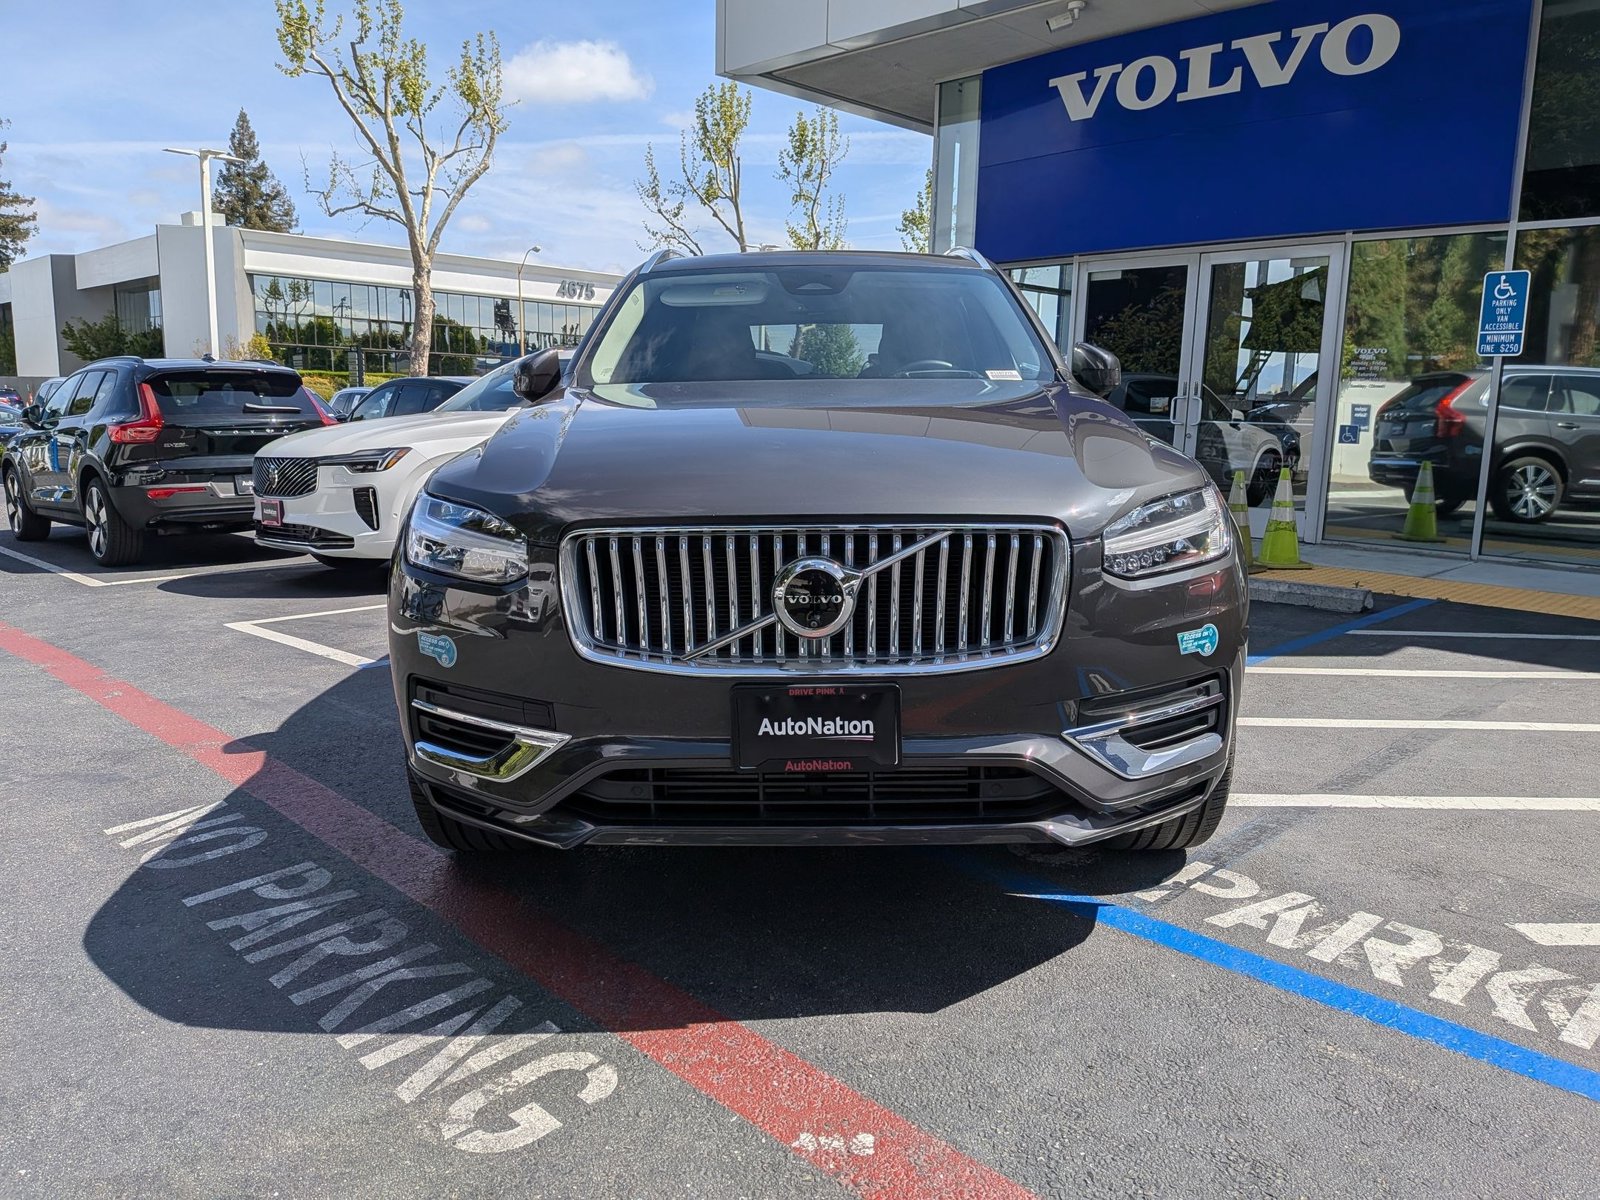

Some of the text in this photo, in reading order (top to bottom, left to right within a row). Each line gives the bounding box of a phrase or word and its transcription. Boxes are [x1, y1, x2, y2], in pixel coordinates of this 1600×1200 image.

[1049, 14, 1400, 121] VOLVO
[556, 280, 595, 301] 4675
[1492, 299, 1517, 307] PARKING
[1495, 307, 1512, 315] ONLY
[1485, 322, 1519, 331] ACCESSIBLE
[1486, 334, 1515, 343] MINIMUM
[1480, 343, 1519, 353] FINE $250
[786, 594, 842, 604] VOLVO
[789, 687, 836, 696] DRIVE PINK
[758, 716, 874, 736] AutoNation
[785, 760, 852, 772] AutoNation
[102, 800, 619, 1153] NO PARKING
